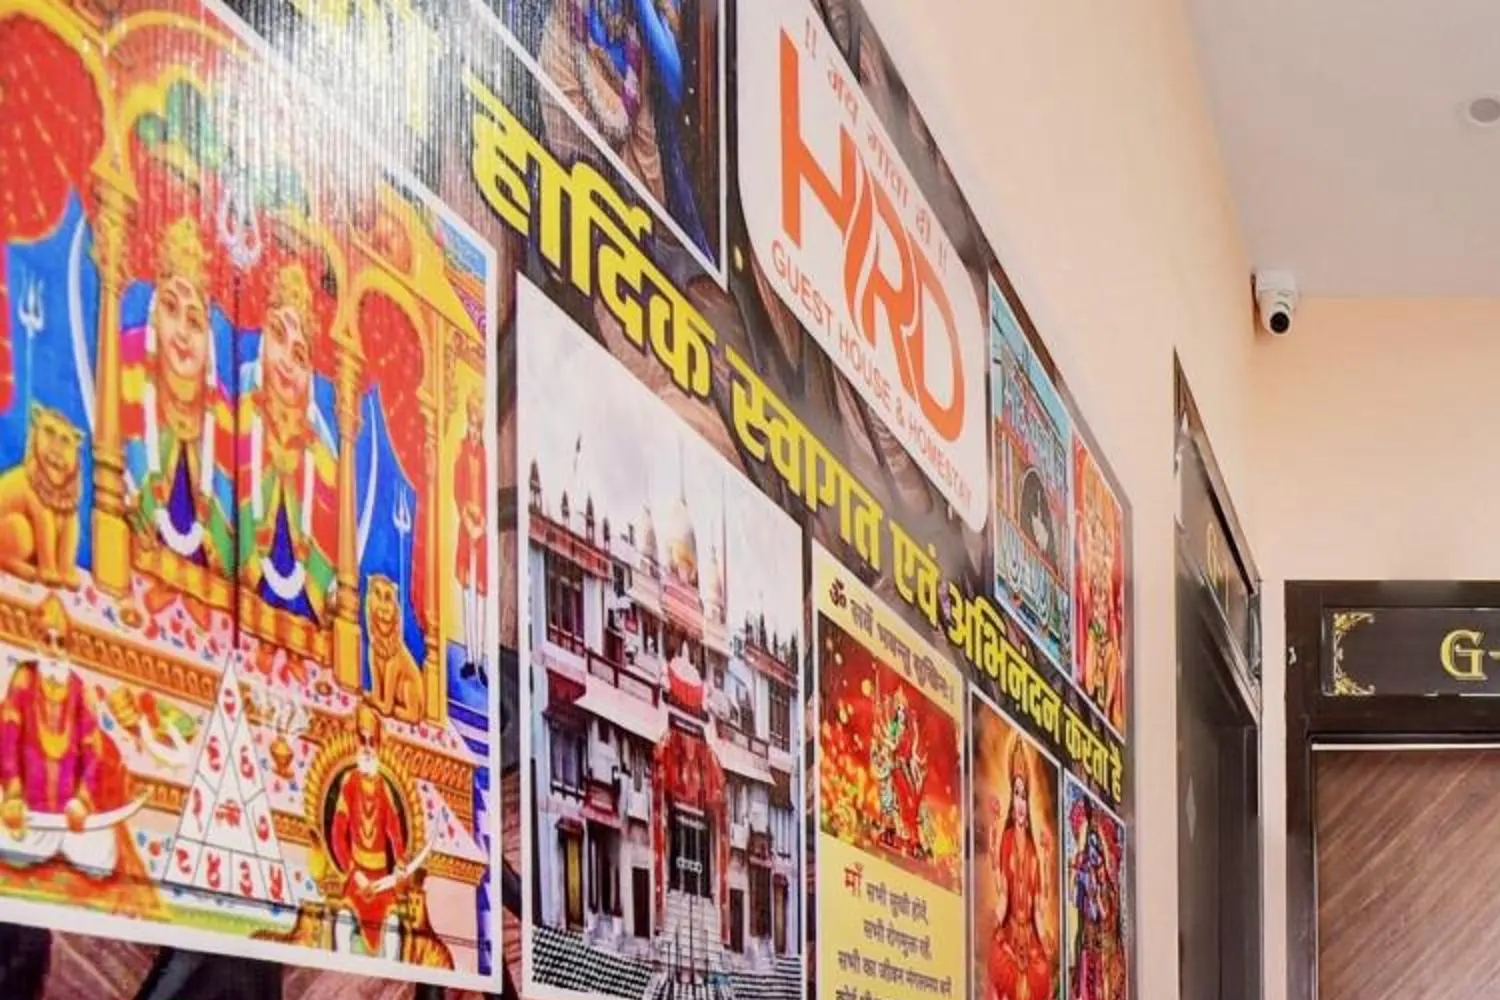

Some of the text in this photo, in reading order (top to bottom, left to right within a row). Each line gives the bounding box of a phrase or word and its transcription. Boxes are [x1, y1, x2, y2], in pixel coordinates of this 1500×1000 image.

[462, 66, 1122, 803] हार्दिक स्वागत एवं अभिनंदन करता है
[771, 239, 834, 336] GUEST
[840, 322, 892, 415] HOUSE
[909, 417, 973, 504] HOMESTAY
[780, 26, 965, 443] HRD
